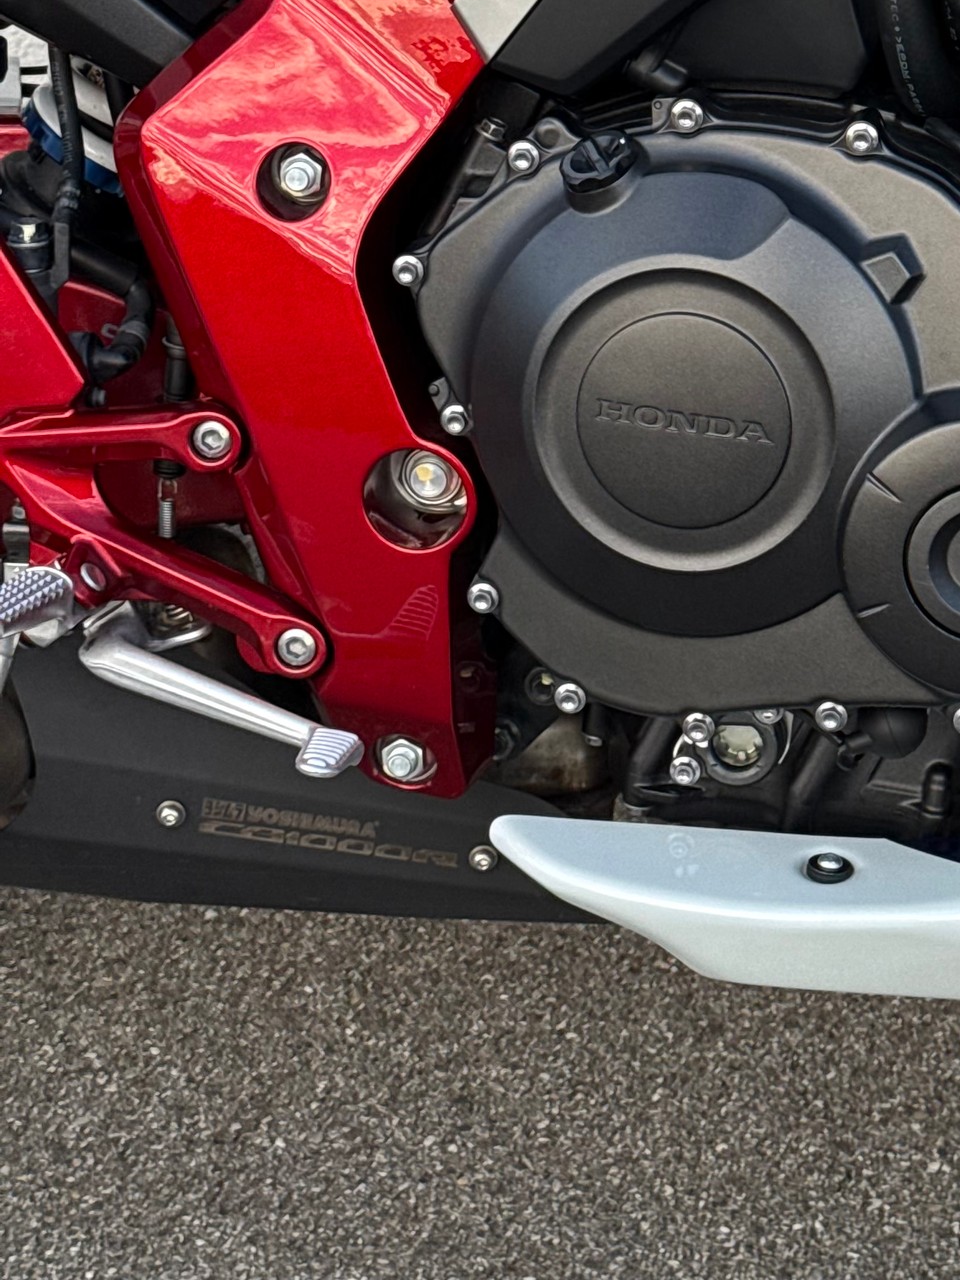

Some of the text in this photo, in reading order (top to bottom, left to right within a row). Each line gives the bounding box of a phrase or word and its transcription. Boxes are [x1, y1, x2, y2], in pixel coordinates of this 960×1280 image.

[595, 398, 775, 445] HONDA
[199, 820, 458, 867] CB1000R
[247, 805, 377, 838] YOSHIMURA
